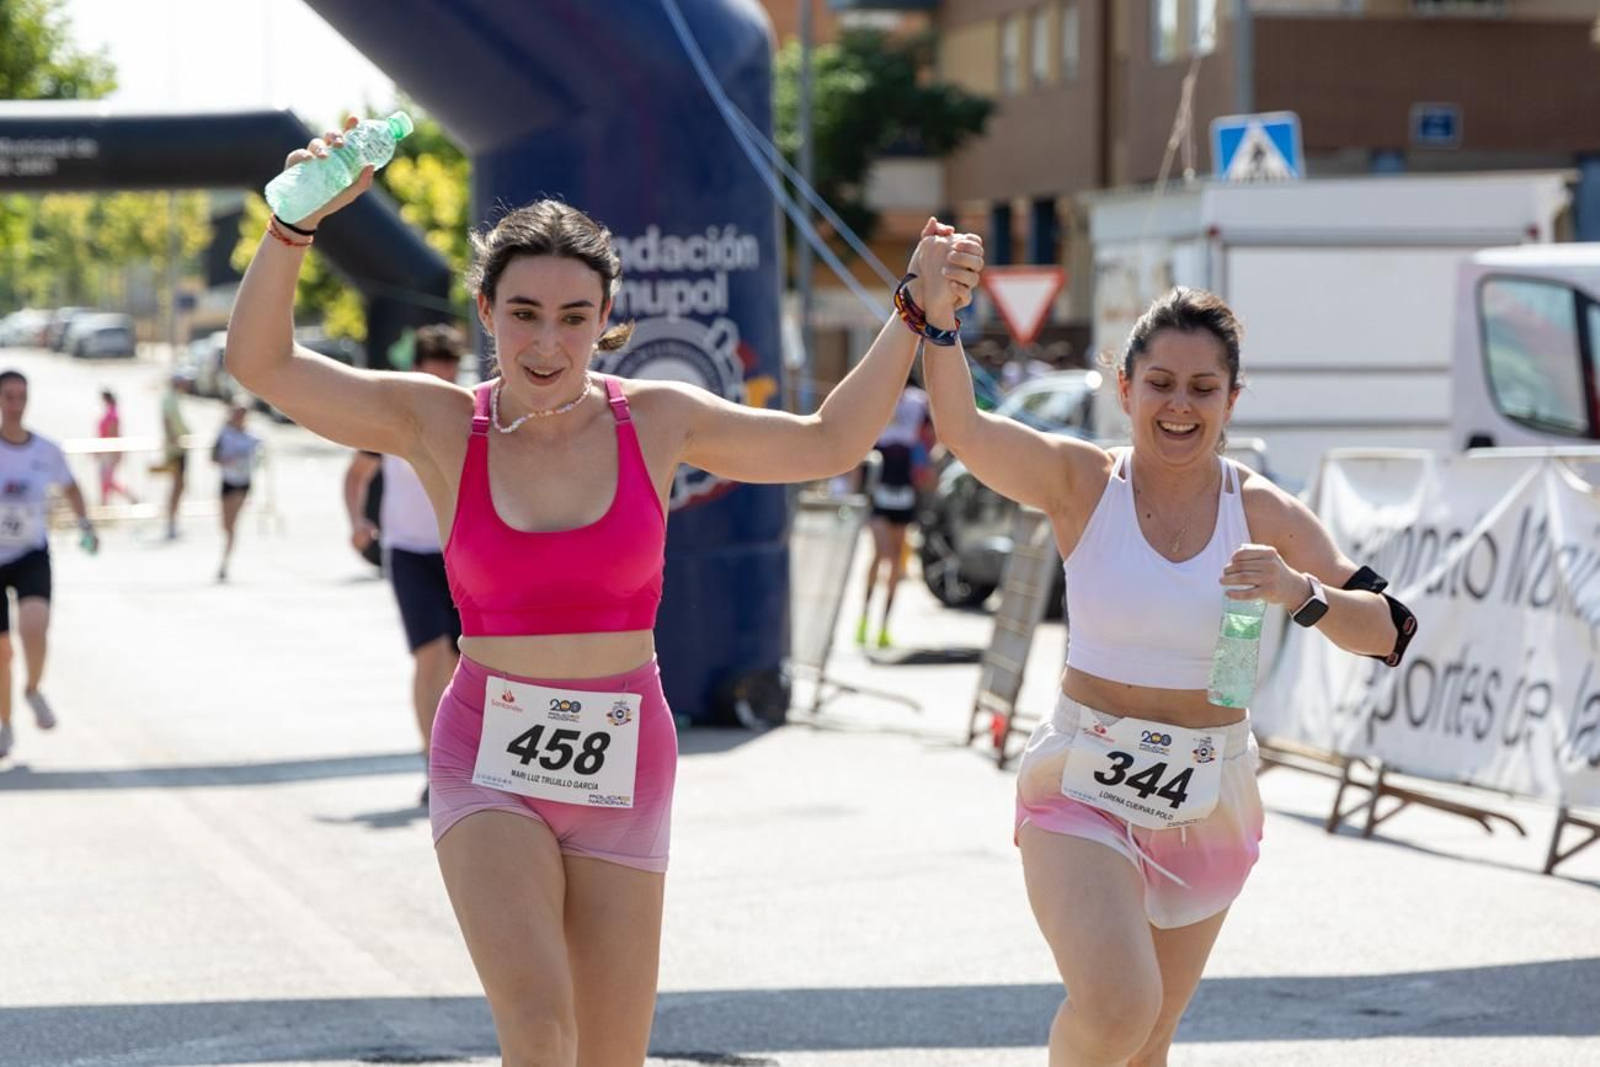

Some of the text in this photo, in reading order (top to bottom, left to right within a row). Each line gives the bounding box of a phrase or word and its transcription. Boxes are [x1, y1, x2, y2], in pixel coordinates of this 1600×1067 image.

[609, 223, 759, 271] ndación
[614, 270, 729, 323] nupol
[1362, 645, 1501, 745] portes
[506, 724, 611, 775] 458
[511, 769, 527, 780] MARI
[527, 774, 541, 783] LUZ
[541, 775, 573, 788] TRUJILLO
[1094, 751, 1194, 809] 344
[1099, 790, 1125, 805] LORENA
[1125, 798, 1155, 816] CUERVAS
[1154, 809, 1174, 821] POLO
